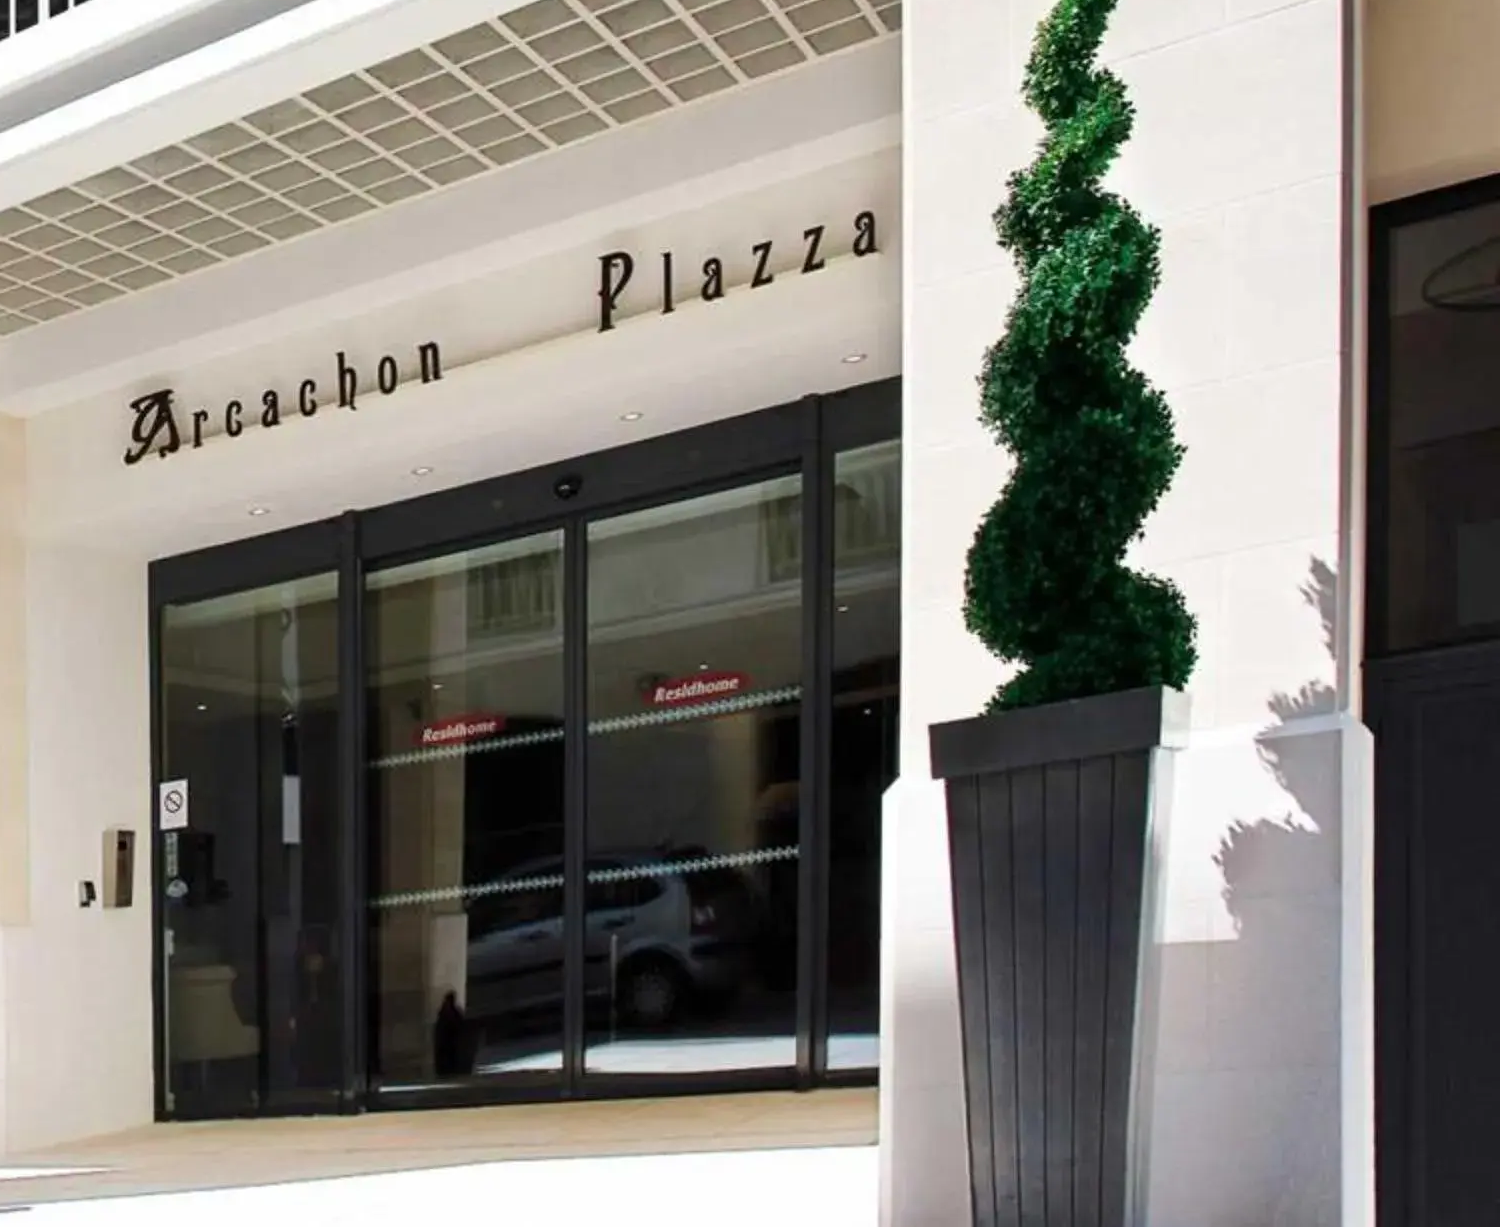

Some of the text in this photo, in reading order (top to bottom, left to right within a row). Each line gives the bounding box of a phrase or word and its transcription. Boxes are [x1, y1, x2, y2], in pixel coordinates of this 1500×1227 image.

[124, 210, 878, 465] Arcachon Plazza
[654, 678, 739, 704] Residhome
[422, 721, 497, 743] Residhome
